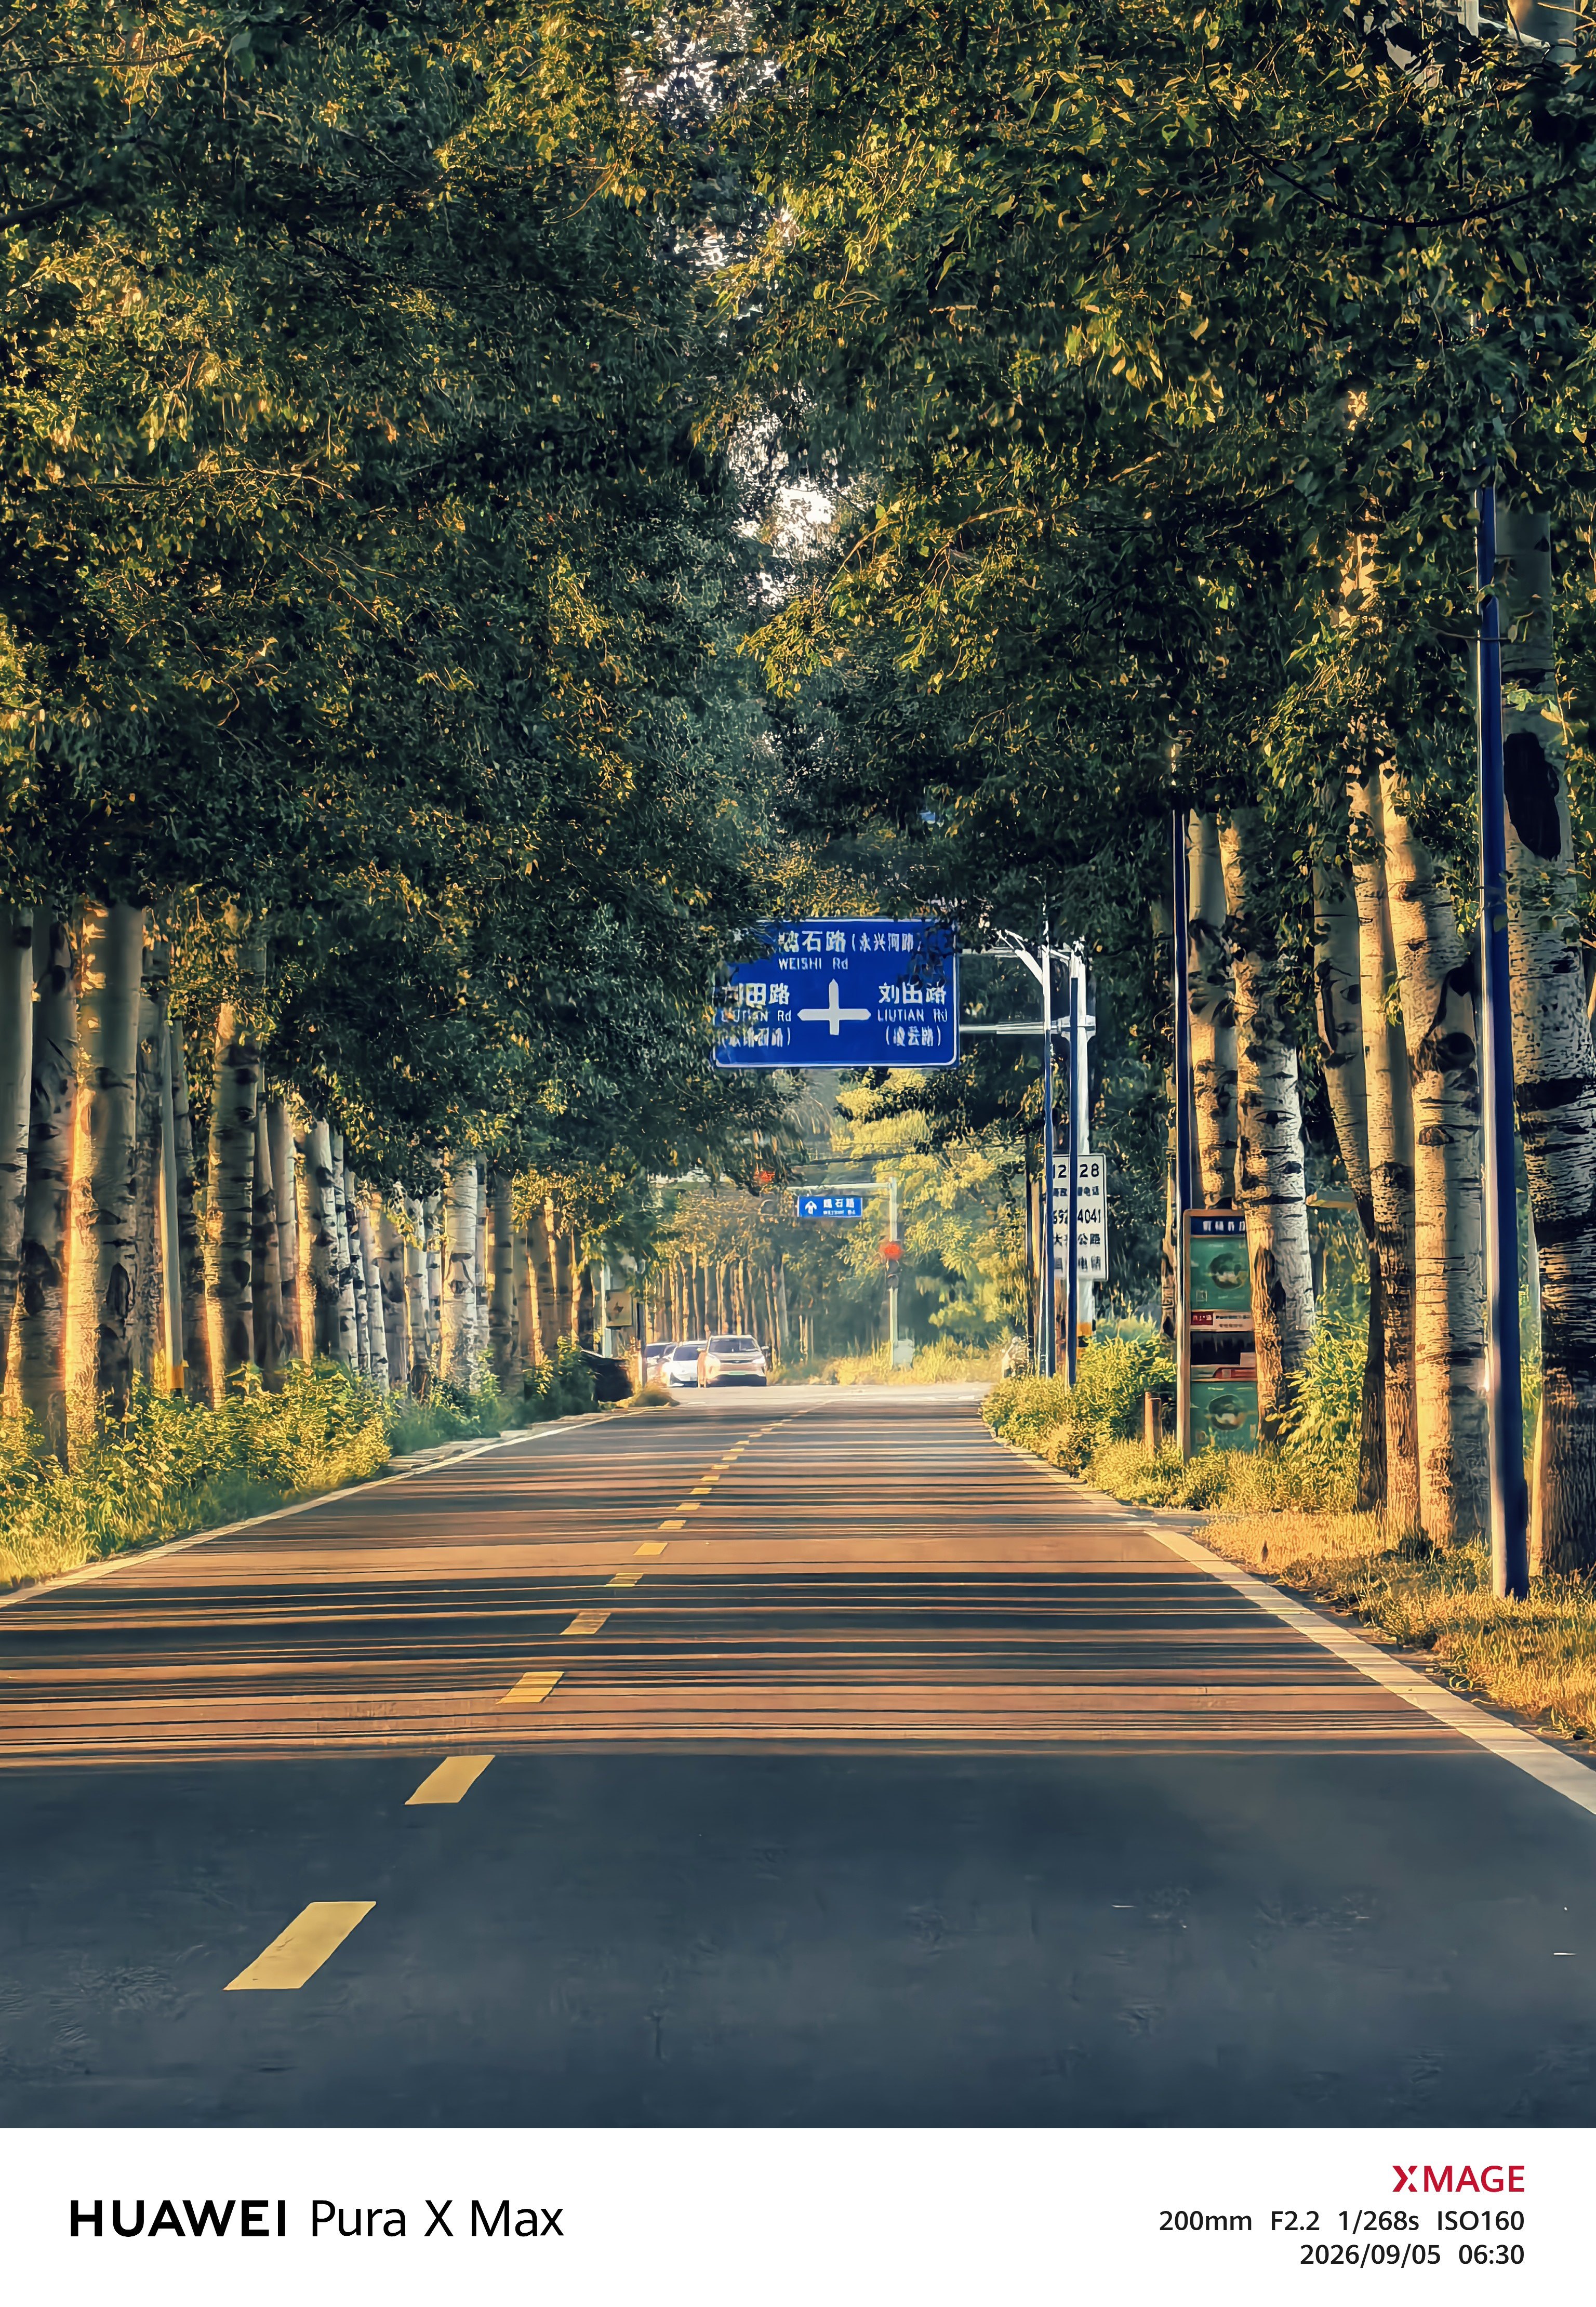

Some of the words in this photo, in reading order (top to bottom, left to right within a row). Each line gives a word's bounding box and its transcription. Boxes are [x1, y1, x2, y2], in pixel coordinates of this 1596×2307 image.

[779, 957, 822, 971] WEISHI
[833, 957, 848, 971] Rd
[879, 982, 947, 1005] 刘田路
[778, 1009, 791, 1022] Rd
[877, 1009, 924, 1022] LIUTIAN
[1053, 1163, 1099, 1178] 1228
